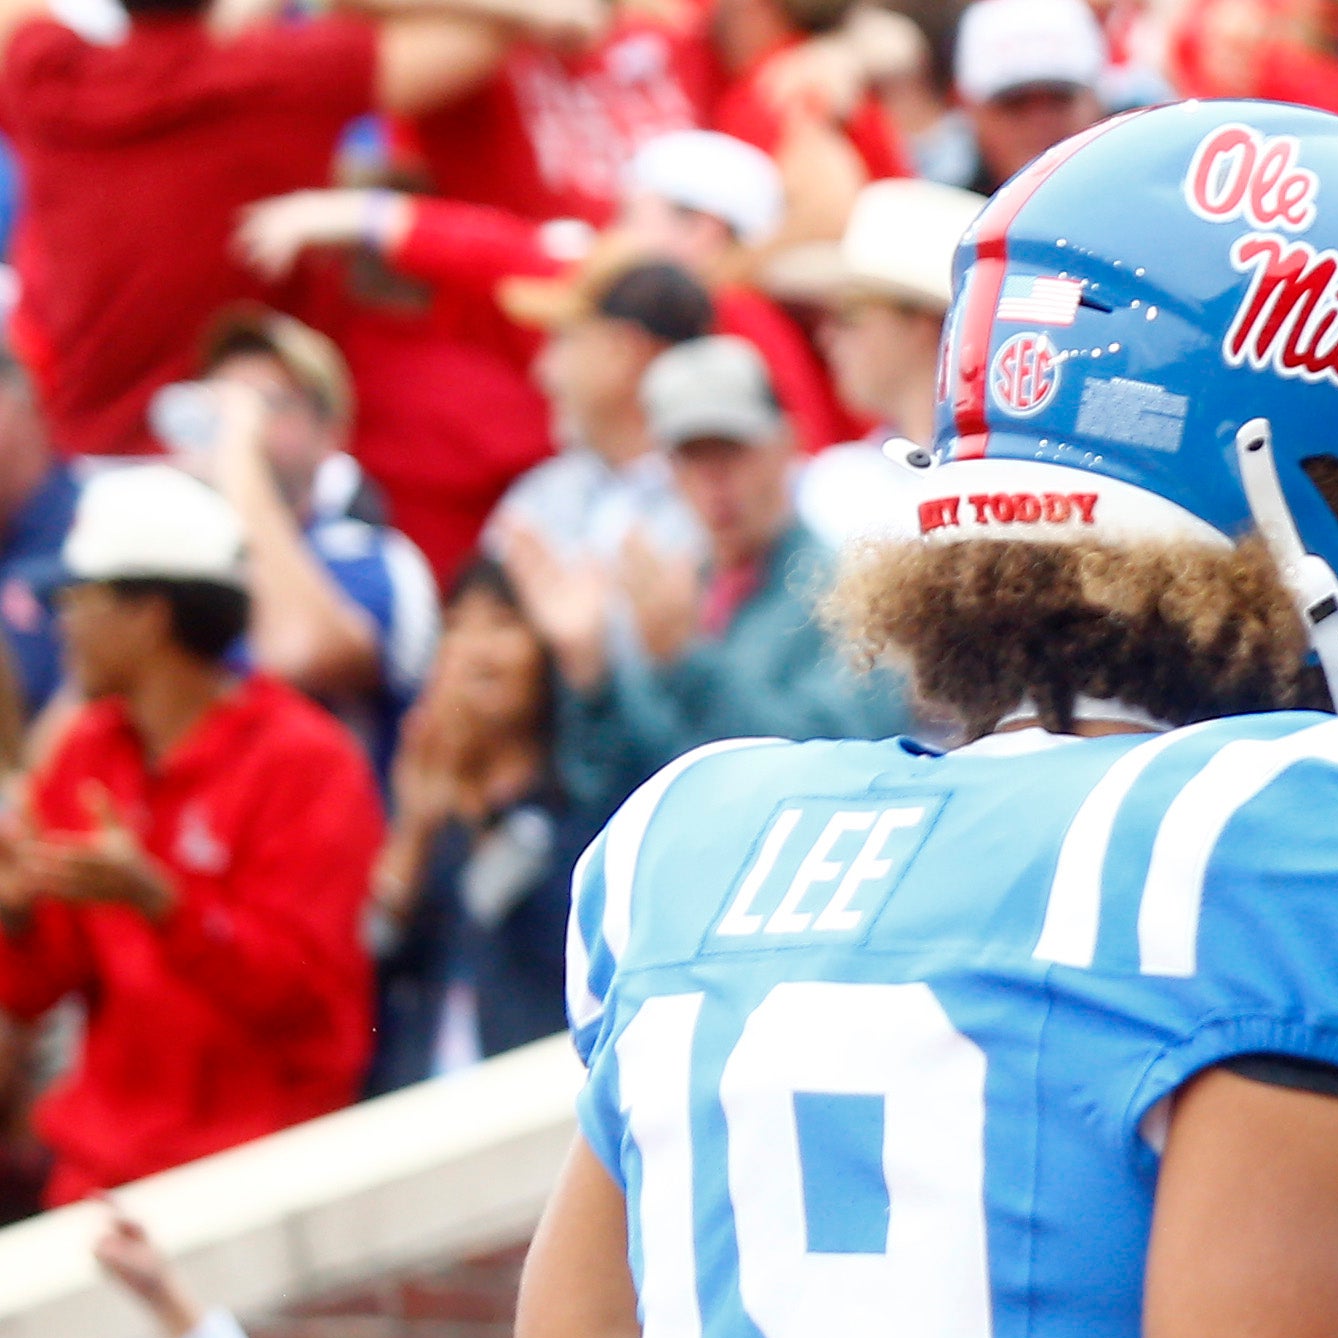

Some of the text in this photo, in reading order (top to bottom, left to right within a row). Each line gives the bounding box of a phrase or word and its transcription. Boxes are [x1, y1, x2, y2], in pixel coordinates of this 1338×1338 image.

[1184, 124, 1318, 230] Ole
[995, 338, 1055, 409] SEC
[969, 492, 1098, 525] TODDY
[715, 805, 926, 938] LEE
